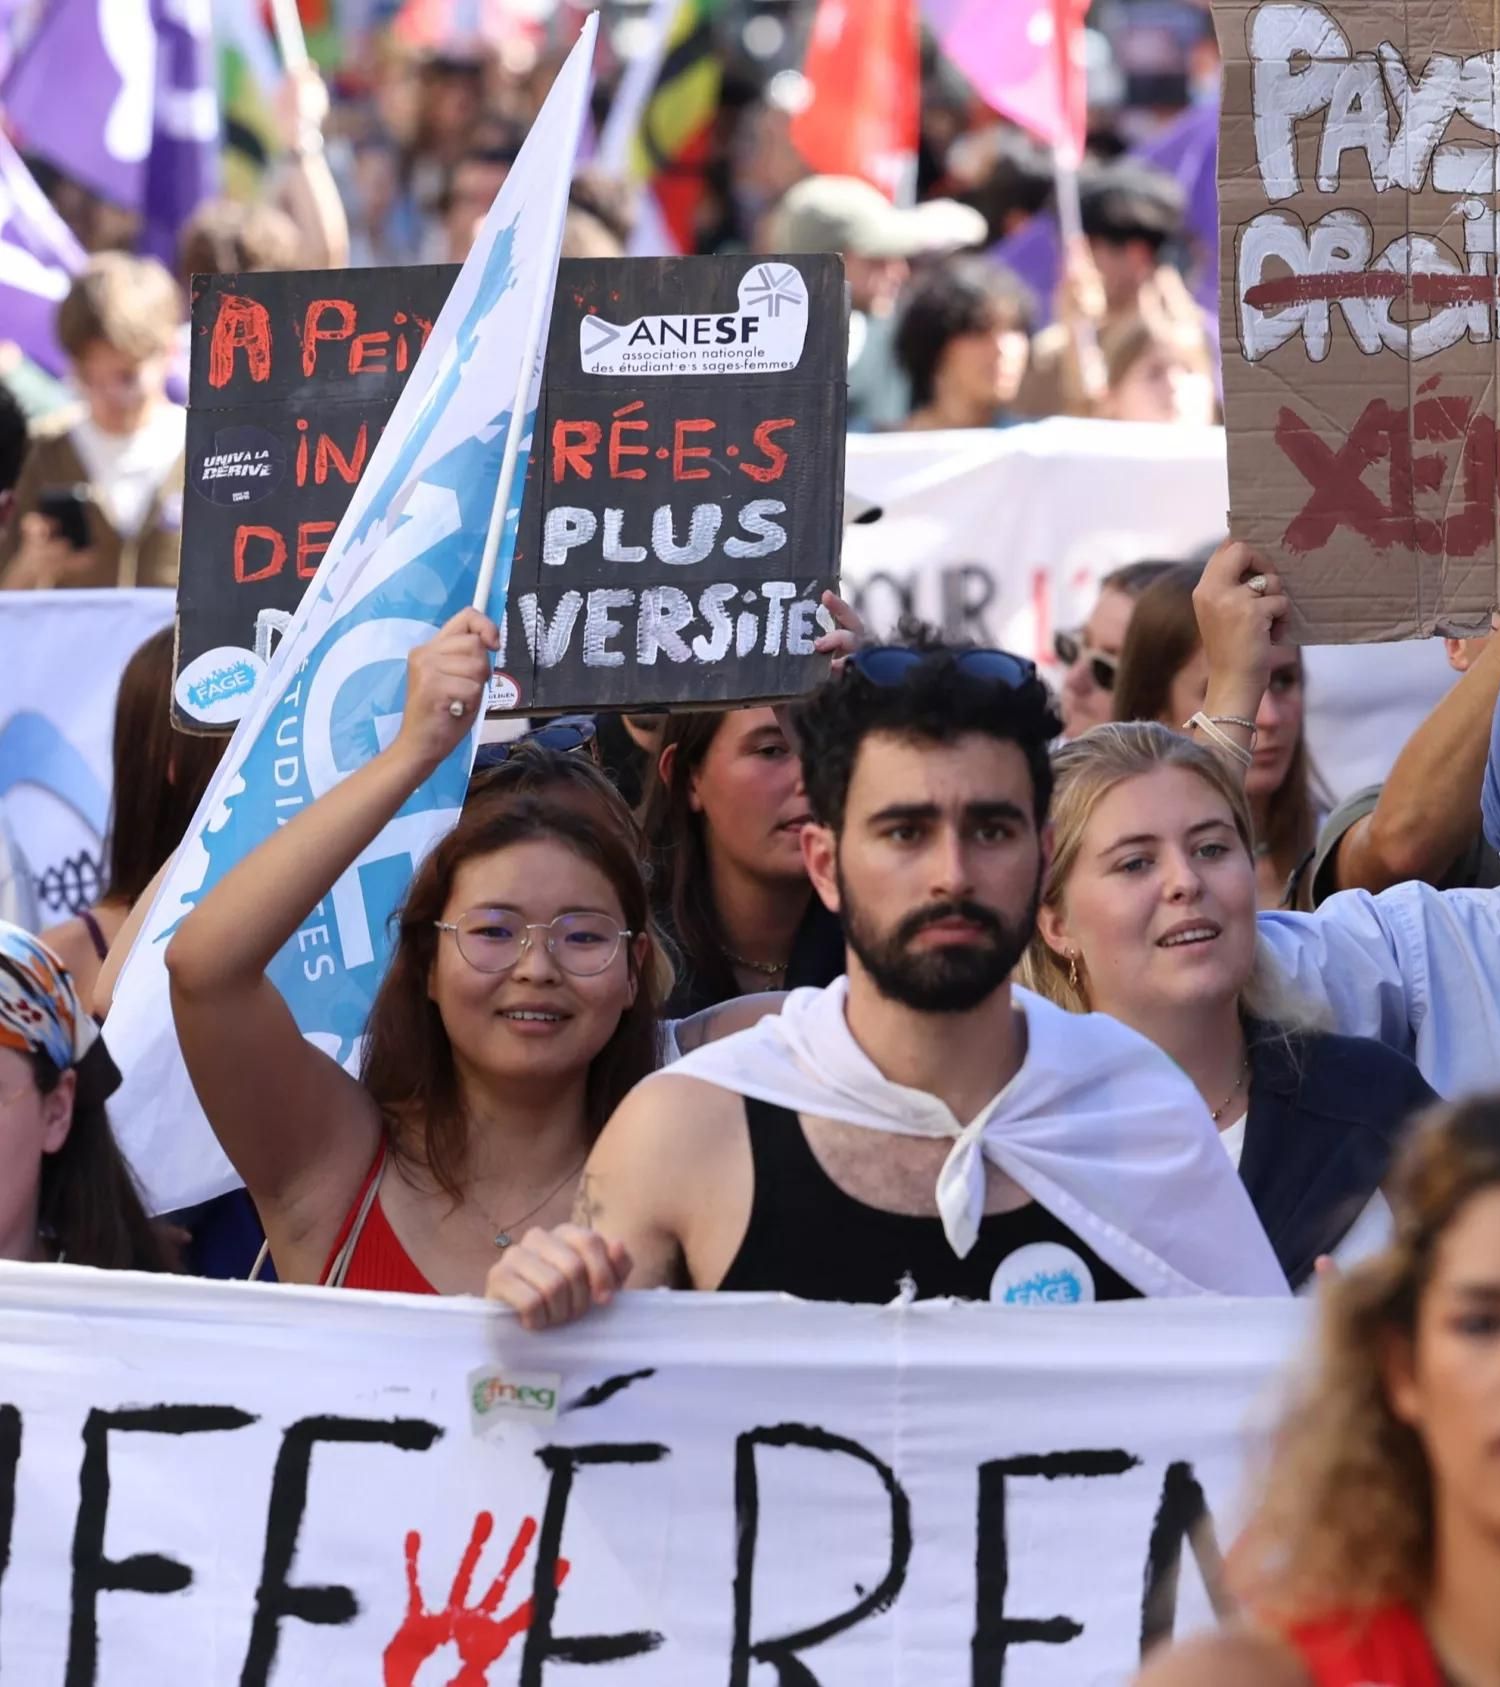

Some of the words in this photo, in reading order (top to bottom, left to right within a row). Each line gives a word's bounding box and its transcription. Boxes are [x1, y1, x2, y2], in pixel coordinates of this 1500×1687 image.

[209, 291, 272, 389] A
[628, 316, 760, 346] ANESF
[591, 362, 614, 374] des
[702, 358, 794, 375] sages-femmes
[622, 349, 697, 361] association
[702, 347, 766, 359] nationale
[203, 452, 245, 468] UNIV
[254, 449, 270, 459] LA
[234, 521, 337, 583] DE
[543, 499, 787, 566] PLUS
[195, 670, 250, 702] FAGE
